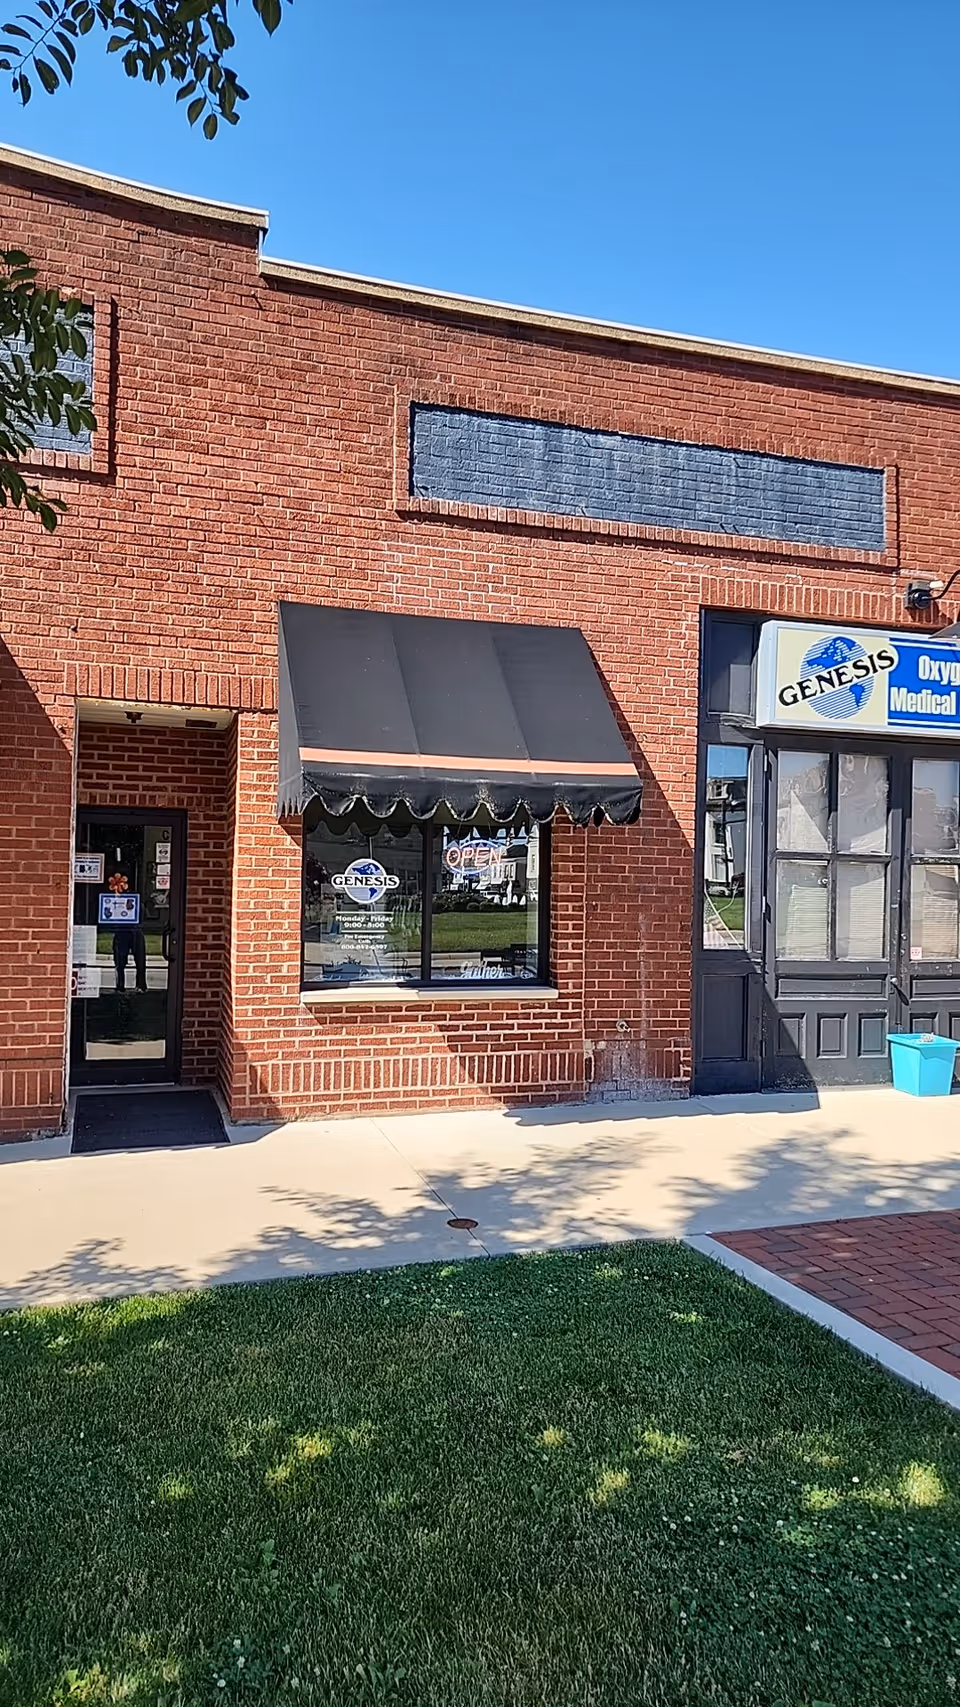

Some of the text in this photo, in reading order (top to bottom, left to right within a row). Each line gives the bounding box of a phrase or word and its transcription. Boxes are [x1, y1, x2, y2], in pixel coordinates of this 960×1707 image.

[778, 650, 895, 706] GENESIS
[890, 687, 957, 715] Medical
[446, 847, 504, 867] OPEN
[332, 876, 398, 887] GENESIS
